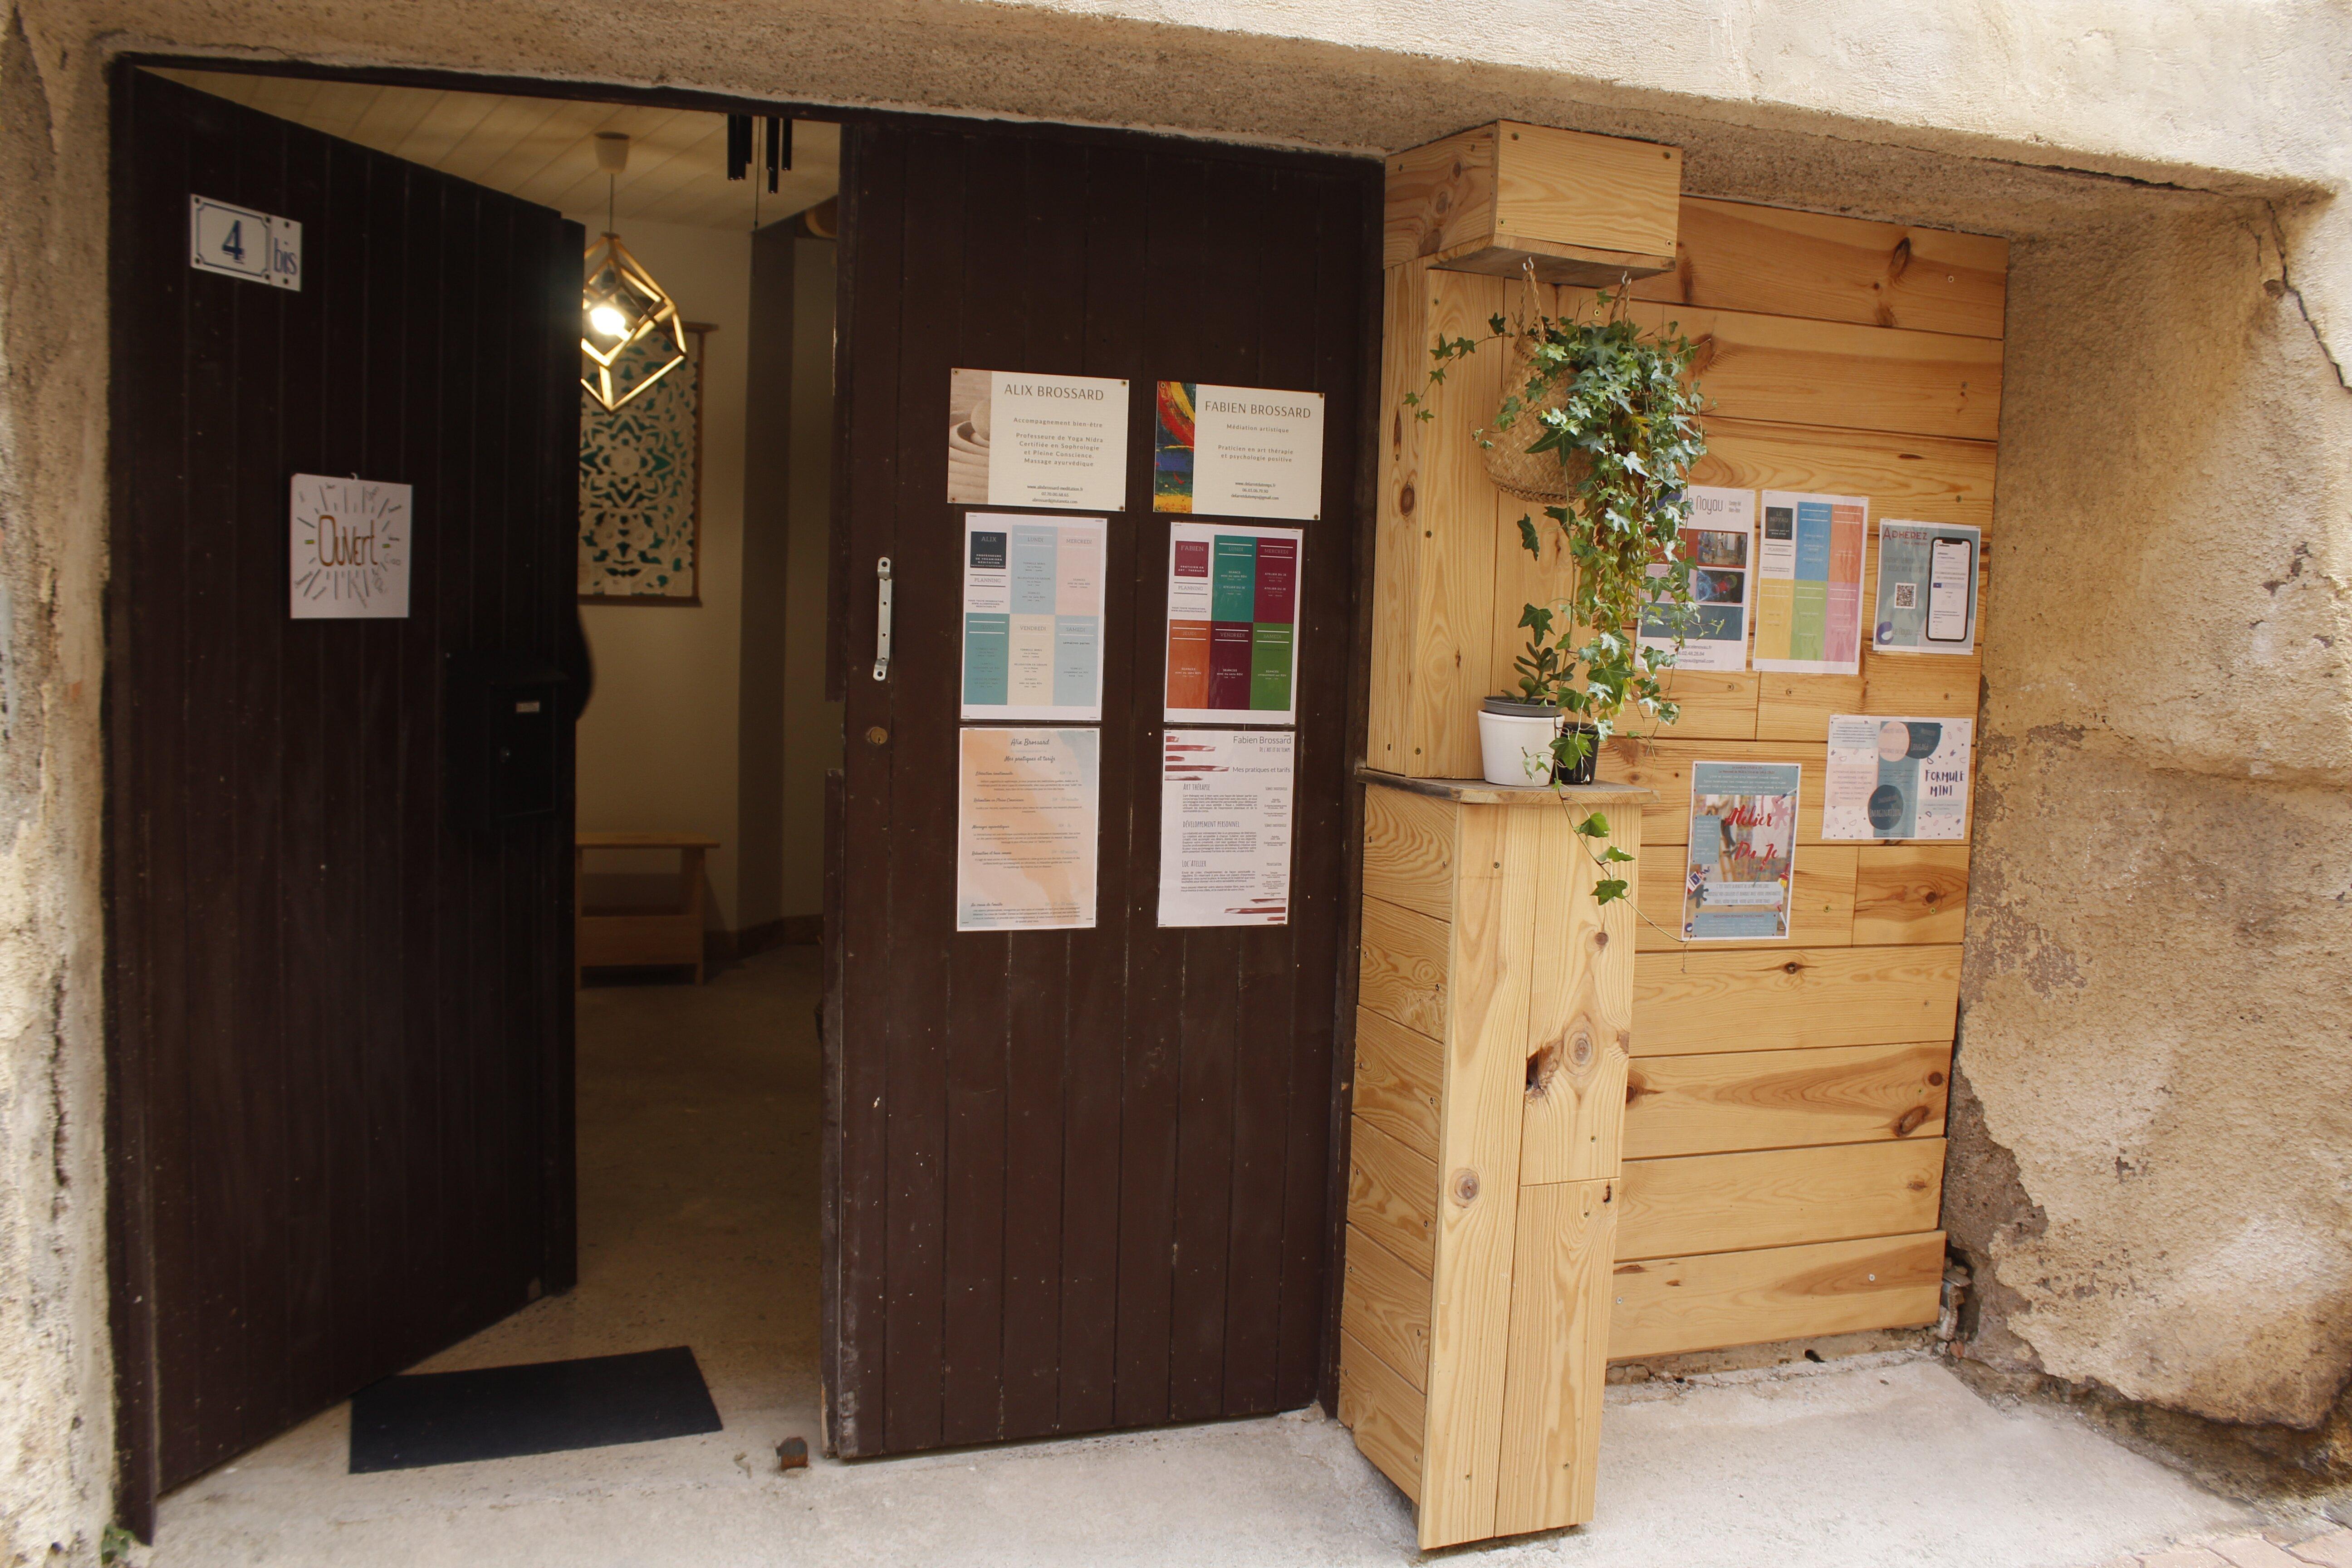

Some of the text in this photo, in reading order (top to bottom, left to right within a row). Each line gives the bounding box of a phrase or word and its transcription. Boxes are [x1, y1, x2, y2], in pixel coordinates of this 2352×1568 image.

[222, 220, 245, 264] 4
[274, 237, 297, 275] bis
[1004, 384, 1104, 401] ALIX BROSSARD
[1205, 401, 1311, 418] FABIEN BROSSARD
[1014, 417, 1070, 426] Accompagnement
[1061, 443, 1099, 451] Sophrologie
[1268, 447, 1294, 455] thérapie
[1054, 459, 1093, 467] ayurvédique
[1230, 453, 1266, 462] psychologie
[1696, 495, 1723, 514] Noyau
[319, 514, 377, 567] Ouvert
[1233, 735, 1291, 744] Fabien Brossard
[1926, 769, 1965, 783] FORMULE
[1930, 785, 1952, 797] MINI
[1724, 804, 1774, 827] Atelier
[1183, 820, 1215, 828] DÉVELOPPEMENT
